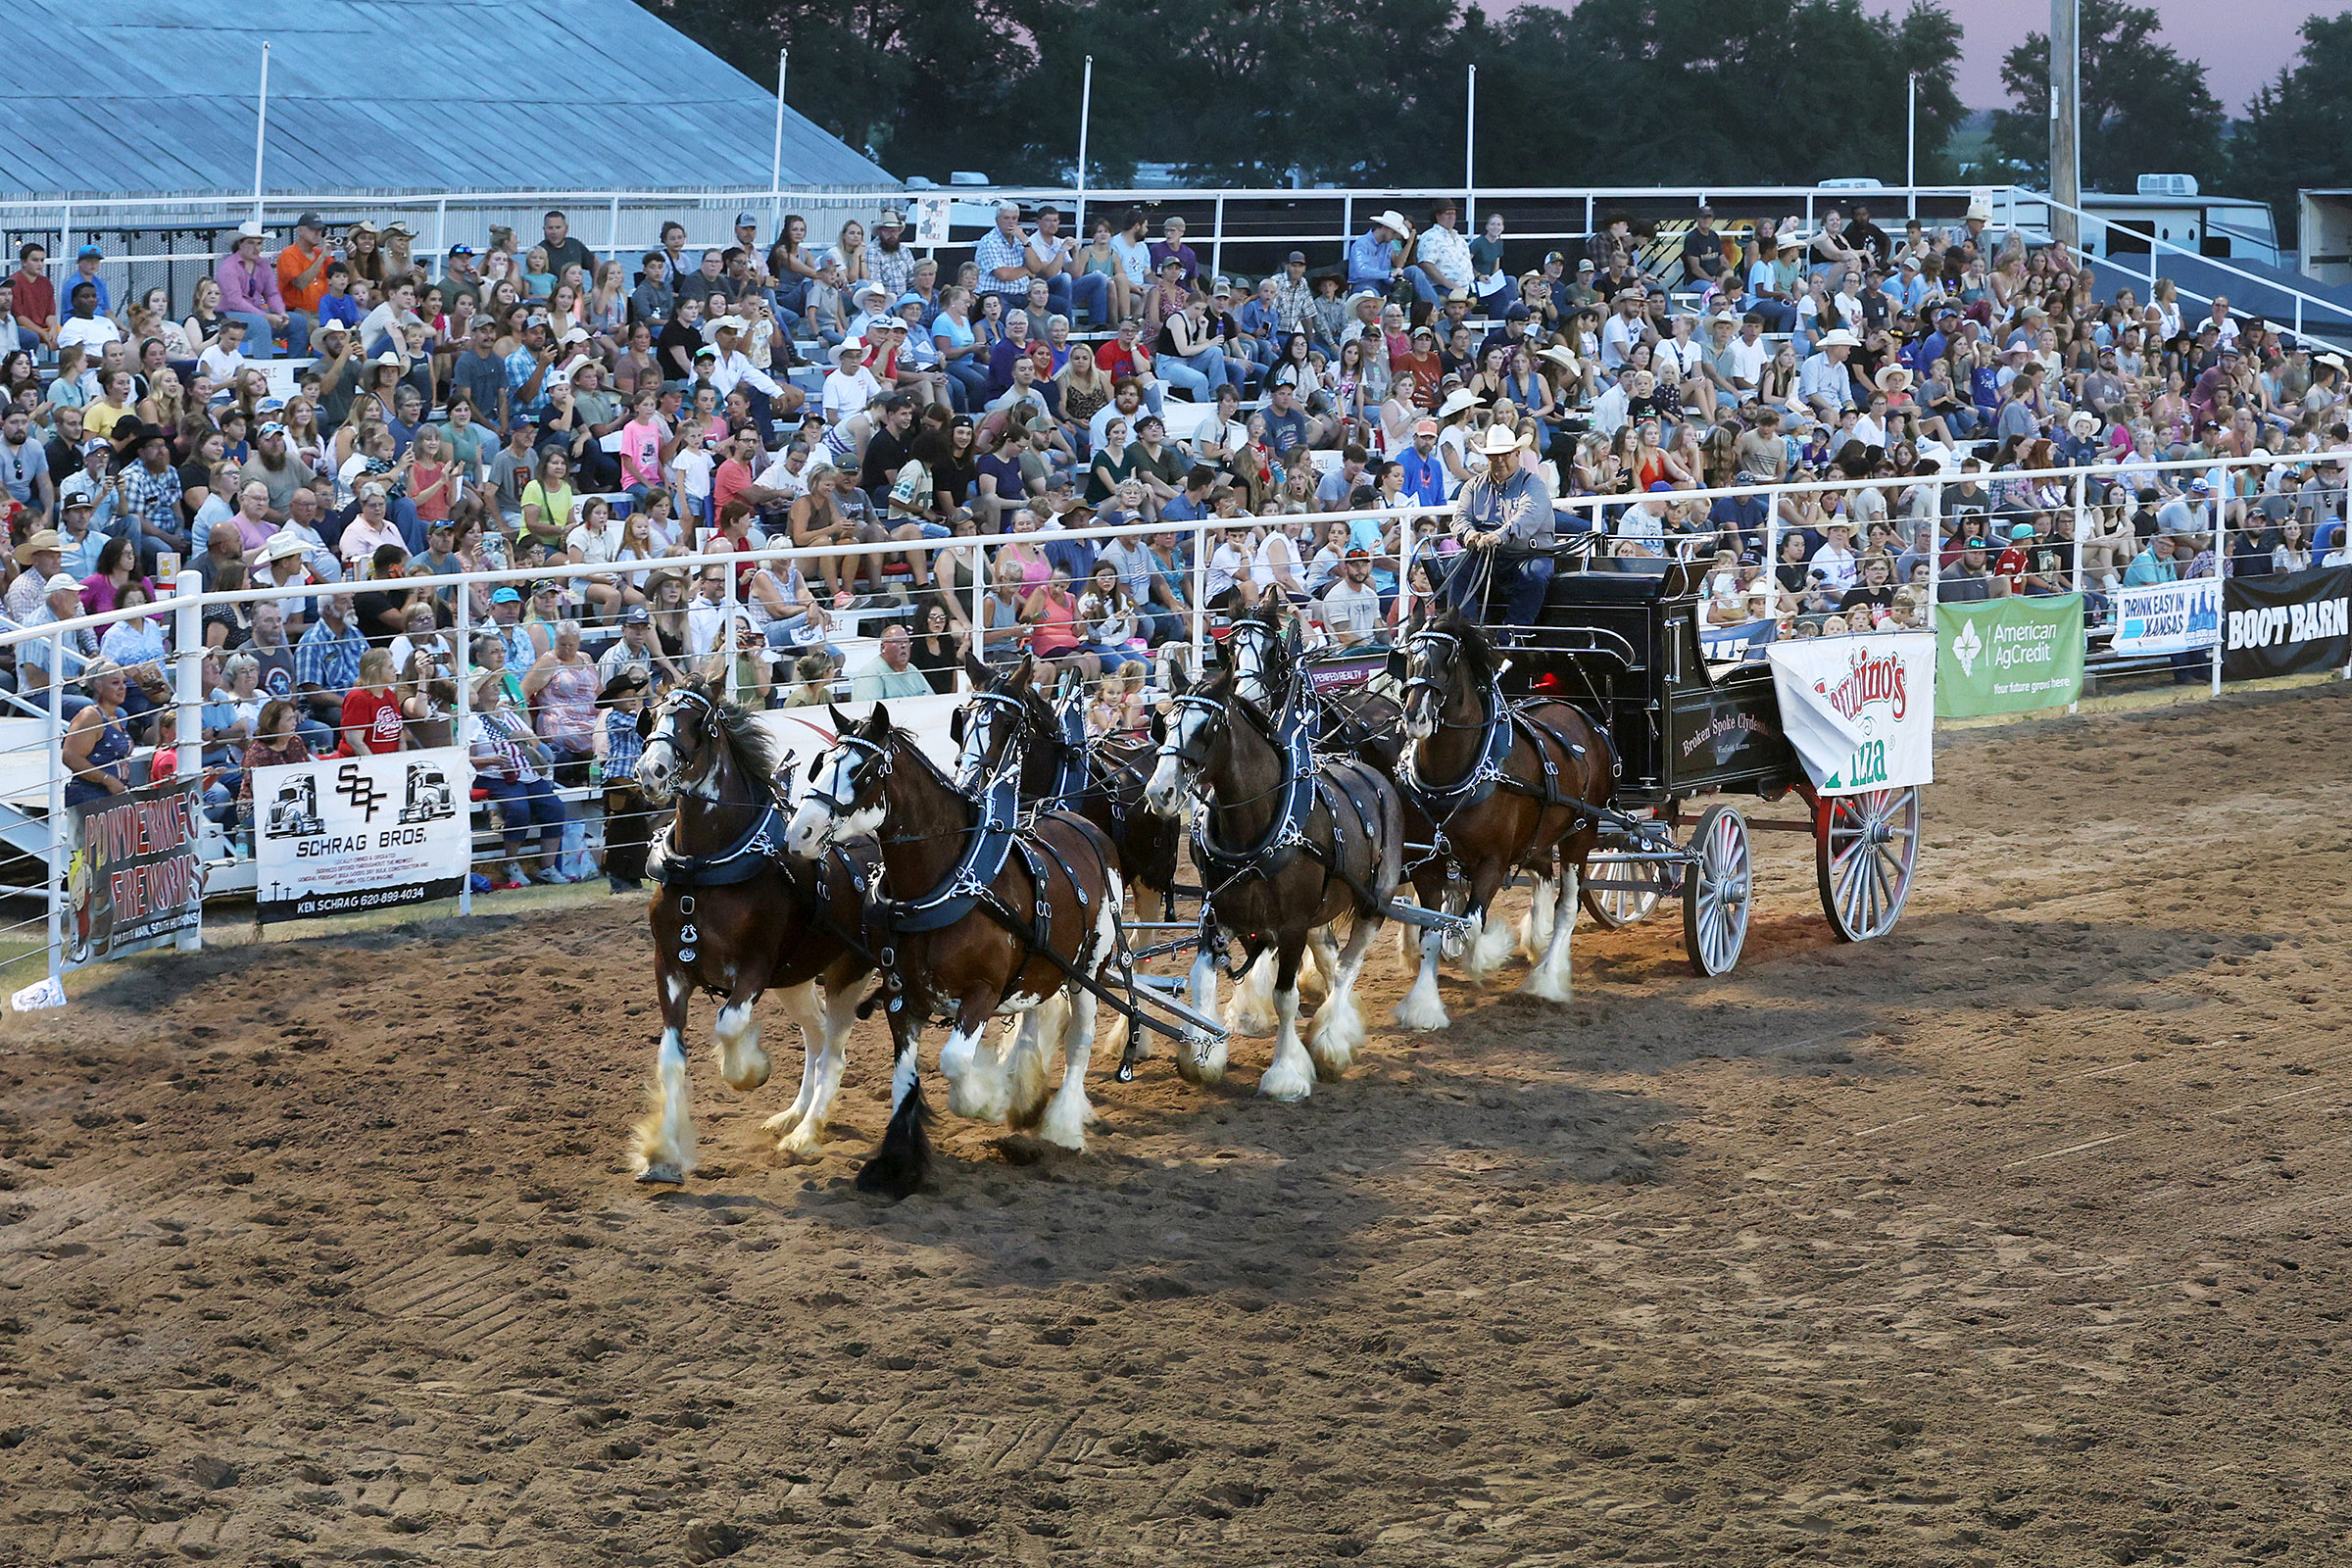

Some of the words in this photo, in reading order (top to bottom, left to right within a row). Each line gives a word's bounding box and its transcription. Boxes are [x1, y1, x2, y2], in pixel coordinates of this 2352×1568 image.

[2125, 596, 2152, 617] DRINK
[2154, 594, 2175, 615] EASY
[2176, 592, 2185, 612] IN
[1993, 620, 2057, 643] American
[2142, 613, 2184, 637] KANSAS
[2228, 607, 2288, 651] BOOT
[2289, 597, 2349, 643] BARN
[1995, 641, 2051, 669] AgCredit
[1339, 670, 1362, 681] REALTY
[1993, 683, 2008, 695] Your
[2009, 681, 2031, 693] future
[2032, 680, 2050, 694] grows
[2051, 676, 2071, 688] here
[1682, 727, 1711, 758] Broken
[1712, 713, 1736, 737] Spoke
[1825, 739, 1887, 788] izza
[296, 834, 368, 858] SCHRAG
[378, 827, 427, 849] BROS.
[298, 901, 316, 913] KEN
[316, 896, 359, 911] SCHRAG
[361, 886, 424, 906] 620-899-4034
